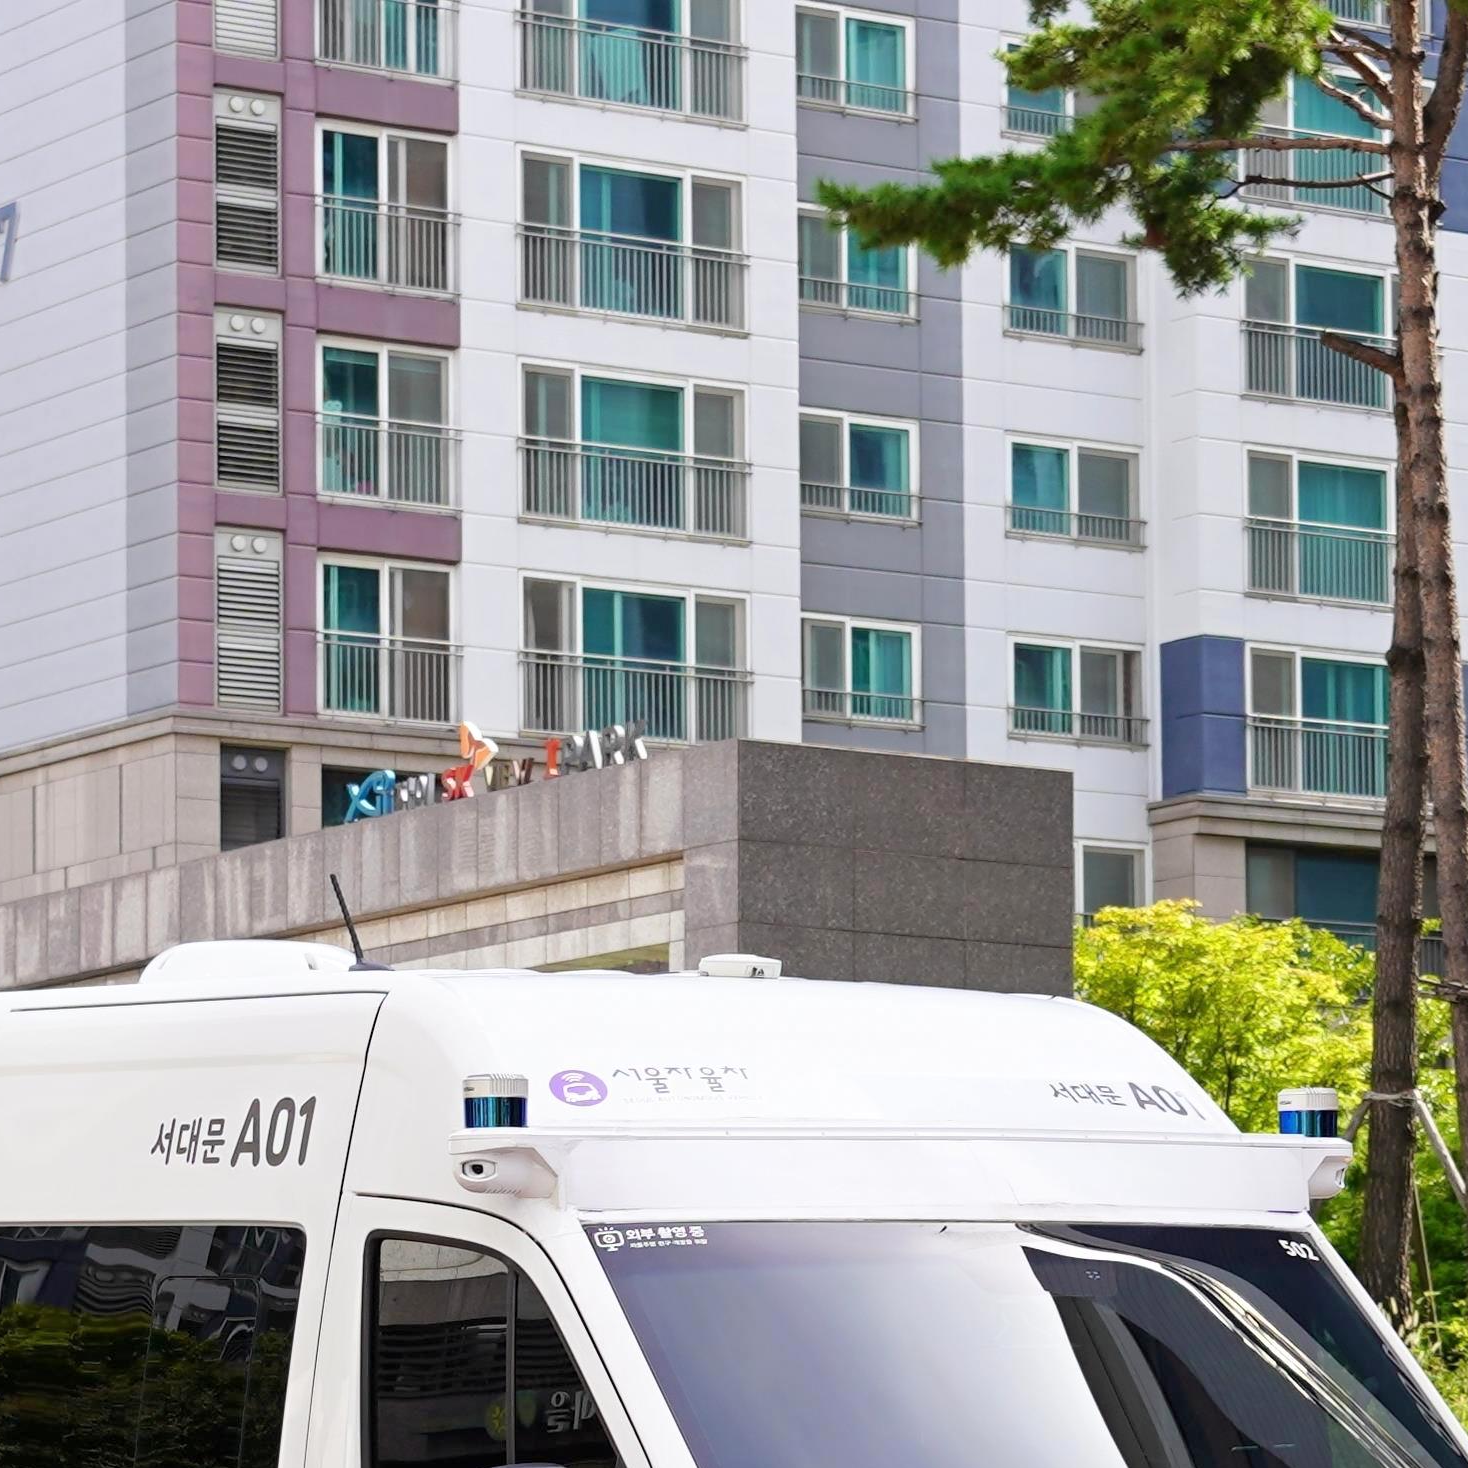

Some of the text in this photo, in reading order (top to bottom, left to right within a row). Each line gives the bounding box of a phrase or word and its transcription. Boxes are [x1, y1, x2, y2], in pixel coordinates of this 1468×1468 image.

[1049, 1082, 1127, 1107] 서대문
[150, 1095, 317, 1168] 서대문 A01
[625, 1228, 656, 1241] 외부
[1277, 1239, 1321, 1262] 502
